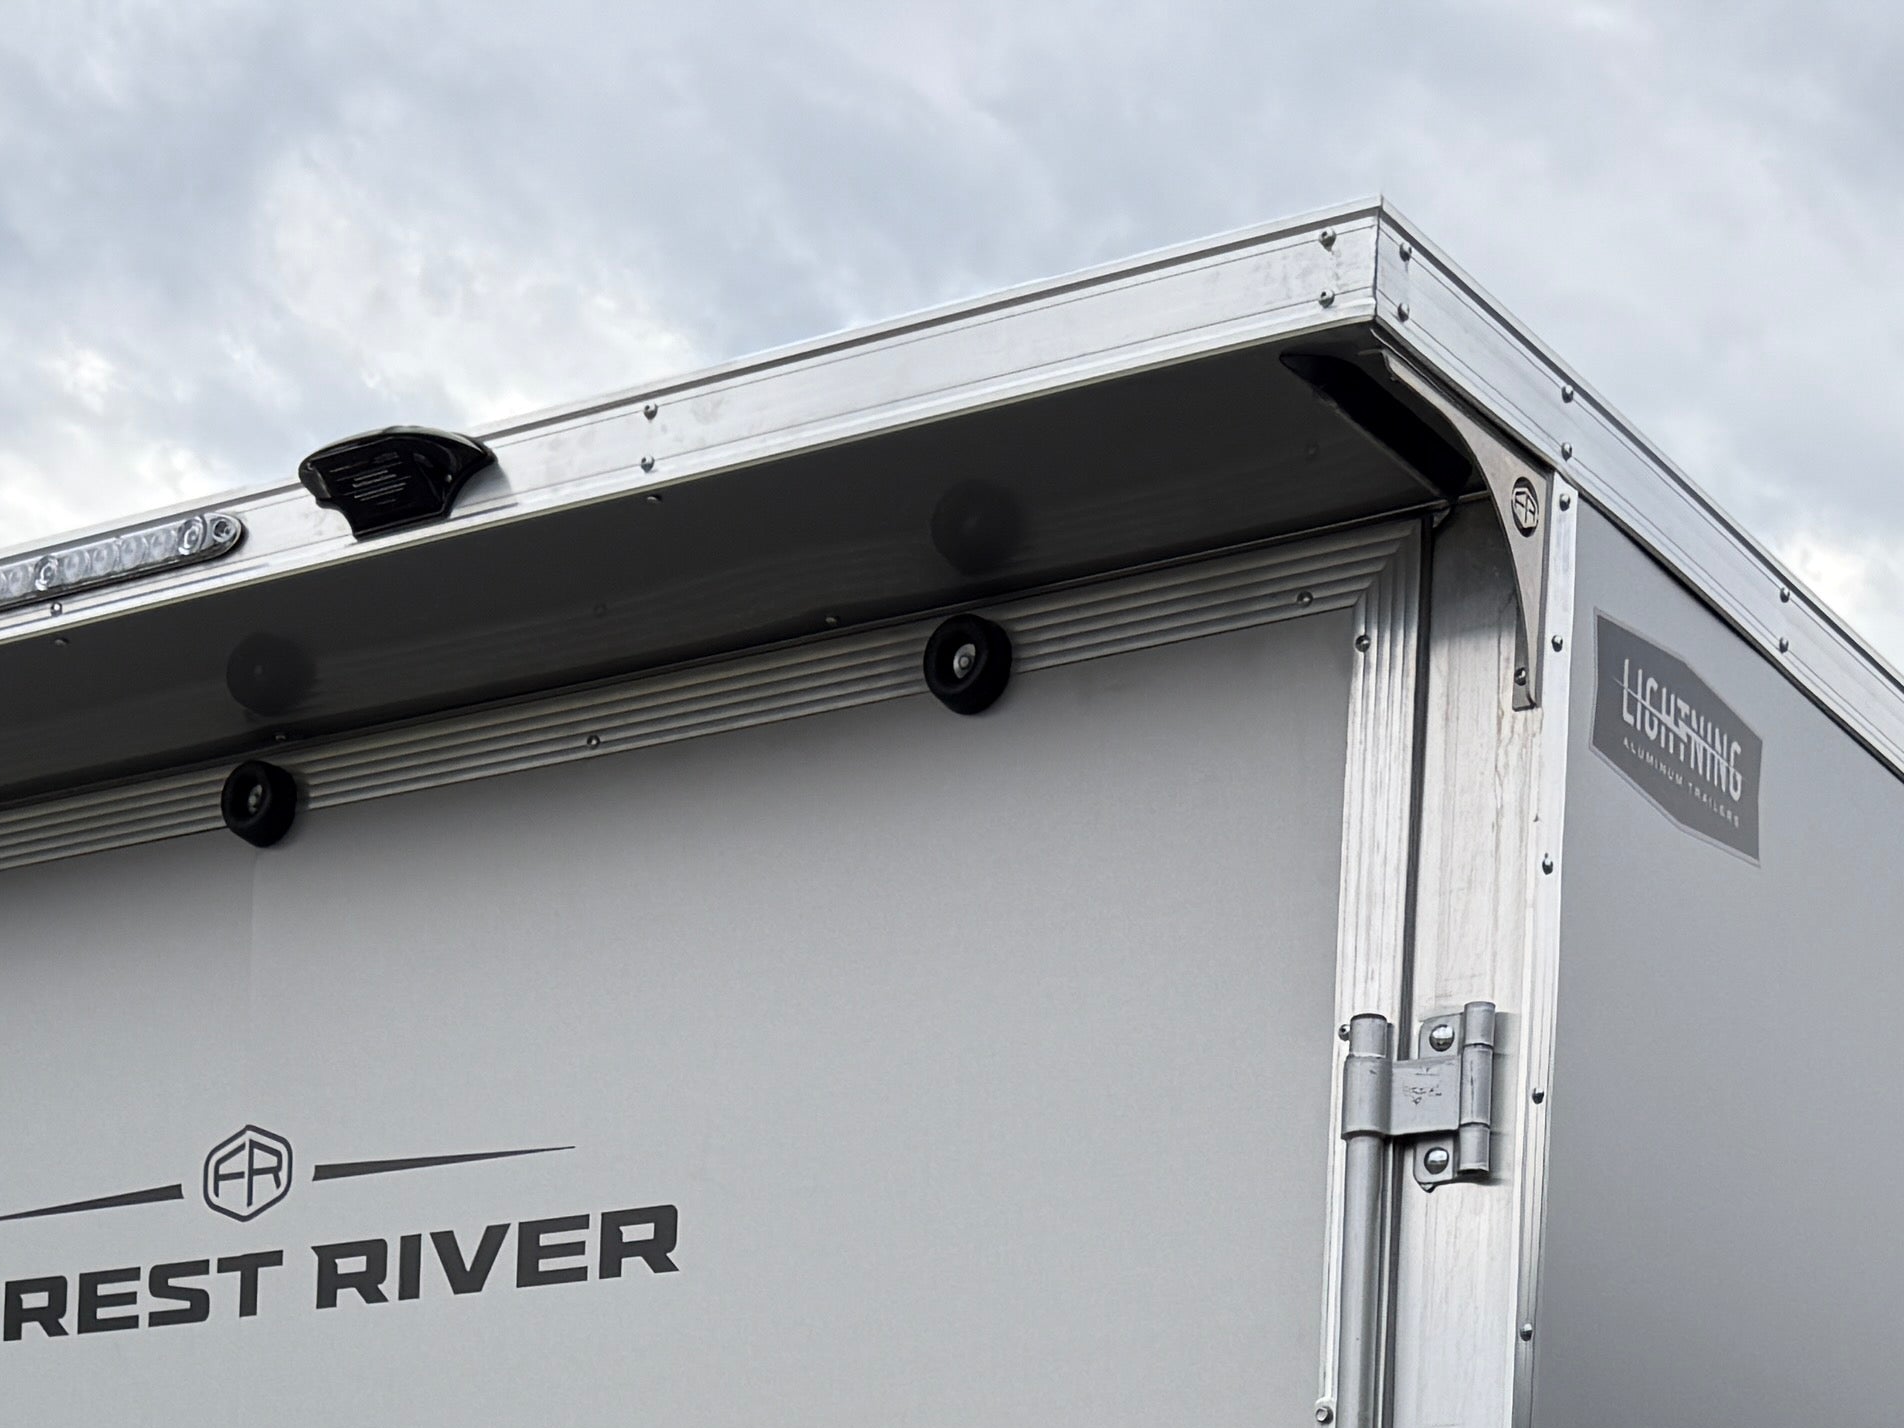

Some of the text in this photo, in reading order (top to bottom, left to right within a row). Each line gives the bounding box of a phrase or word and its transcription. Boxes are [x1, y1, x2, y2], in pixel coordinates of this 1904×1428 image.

[1623, 659, 1742, 802] LIGHTNING
[1623, 737, 1741, 829] ALUMINUM TRAILERS
[311, 1203, 680, 1310] RIVER
